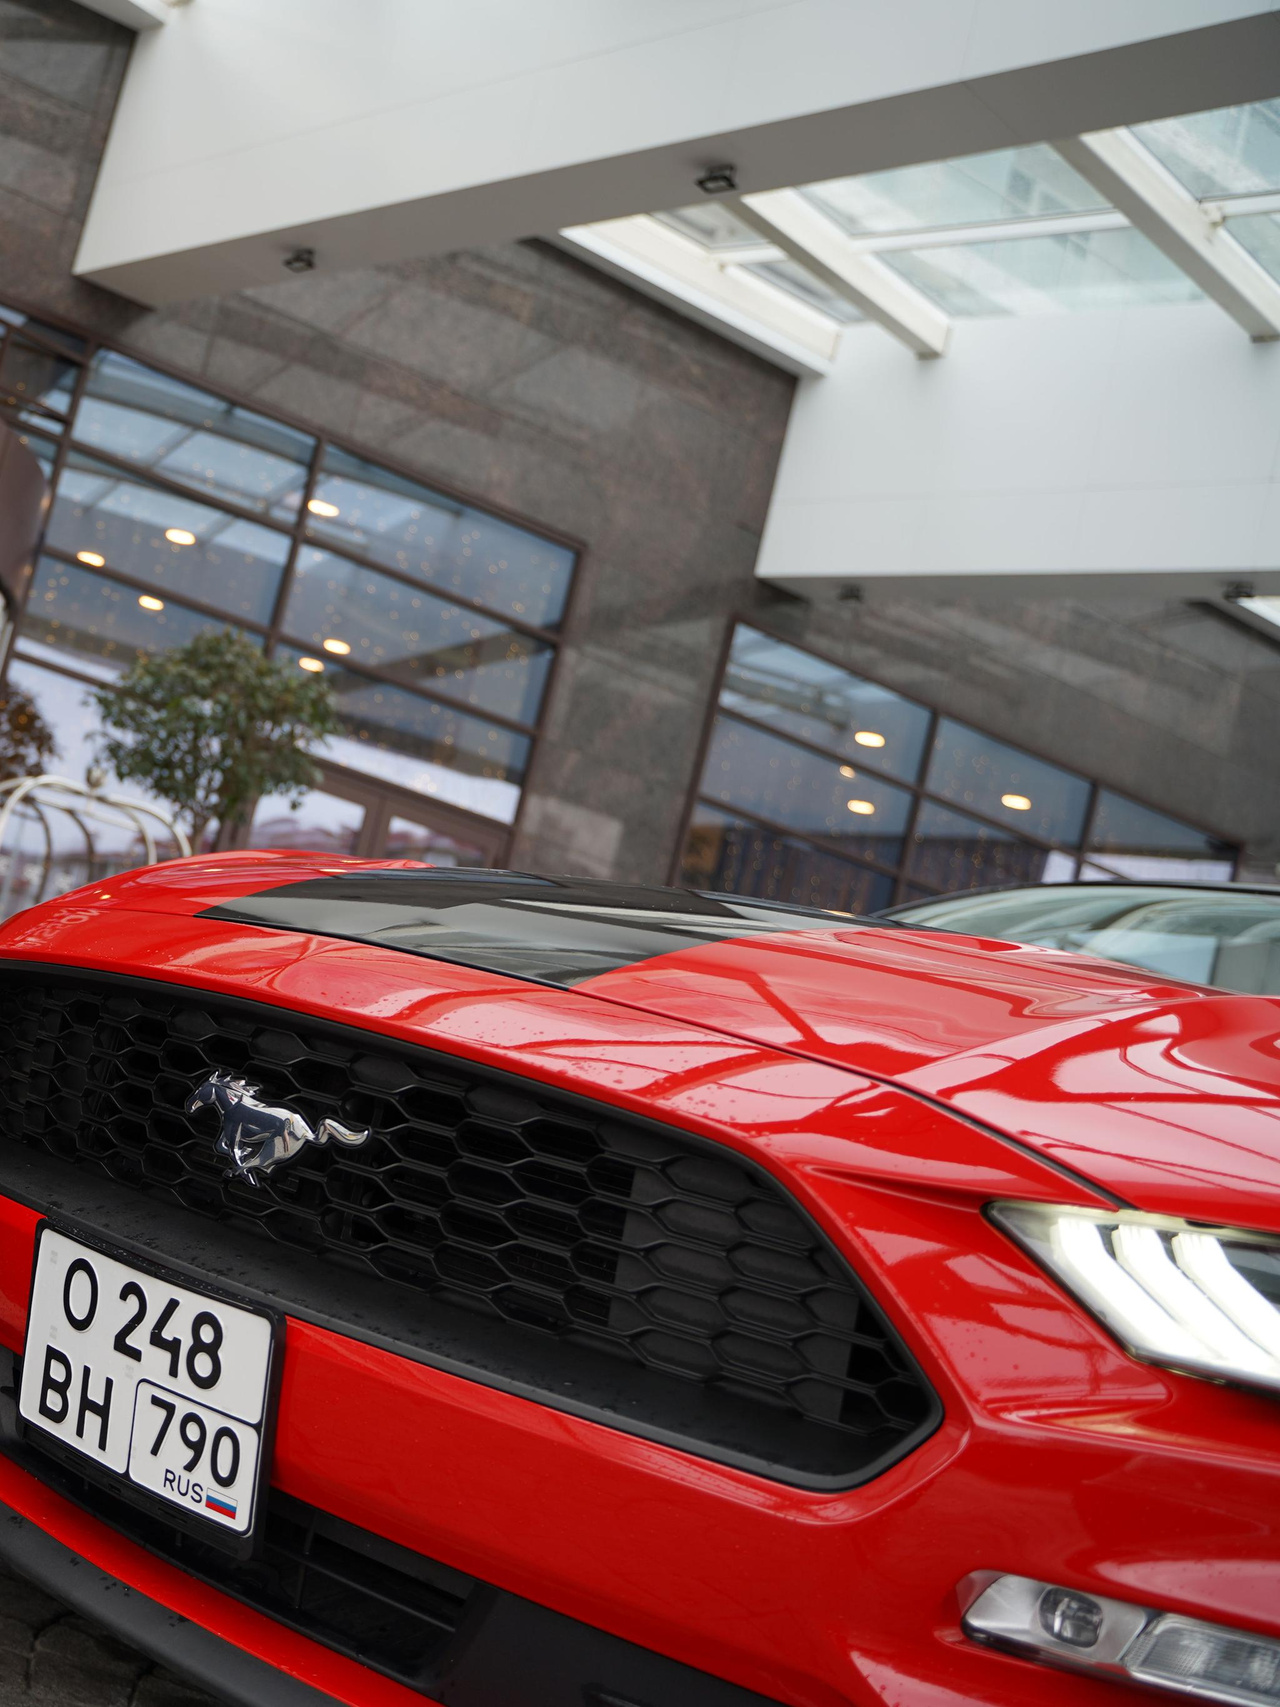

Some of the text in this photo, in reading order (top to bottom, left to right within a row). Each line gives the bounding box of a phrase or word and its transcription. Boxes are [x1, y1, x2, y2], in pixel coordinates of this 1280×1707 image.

[113, 1280, 224, 1390] 248
[150, 1394, 240, 1488] 790
[163, 1468, 203, 1504] RUS
